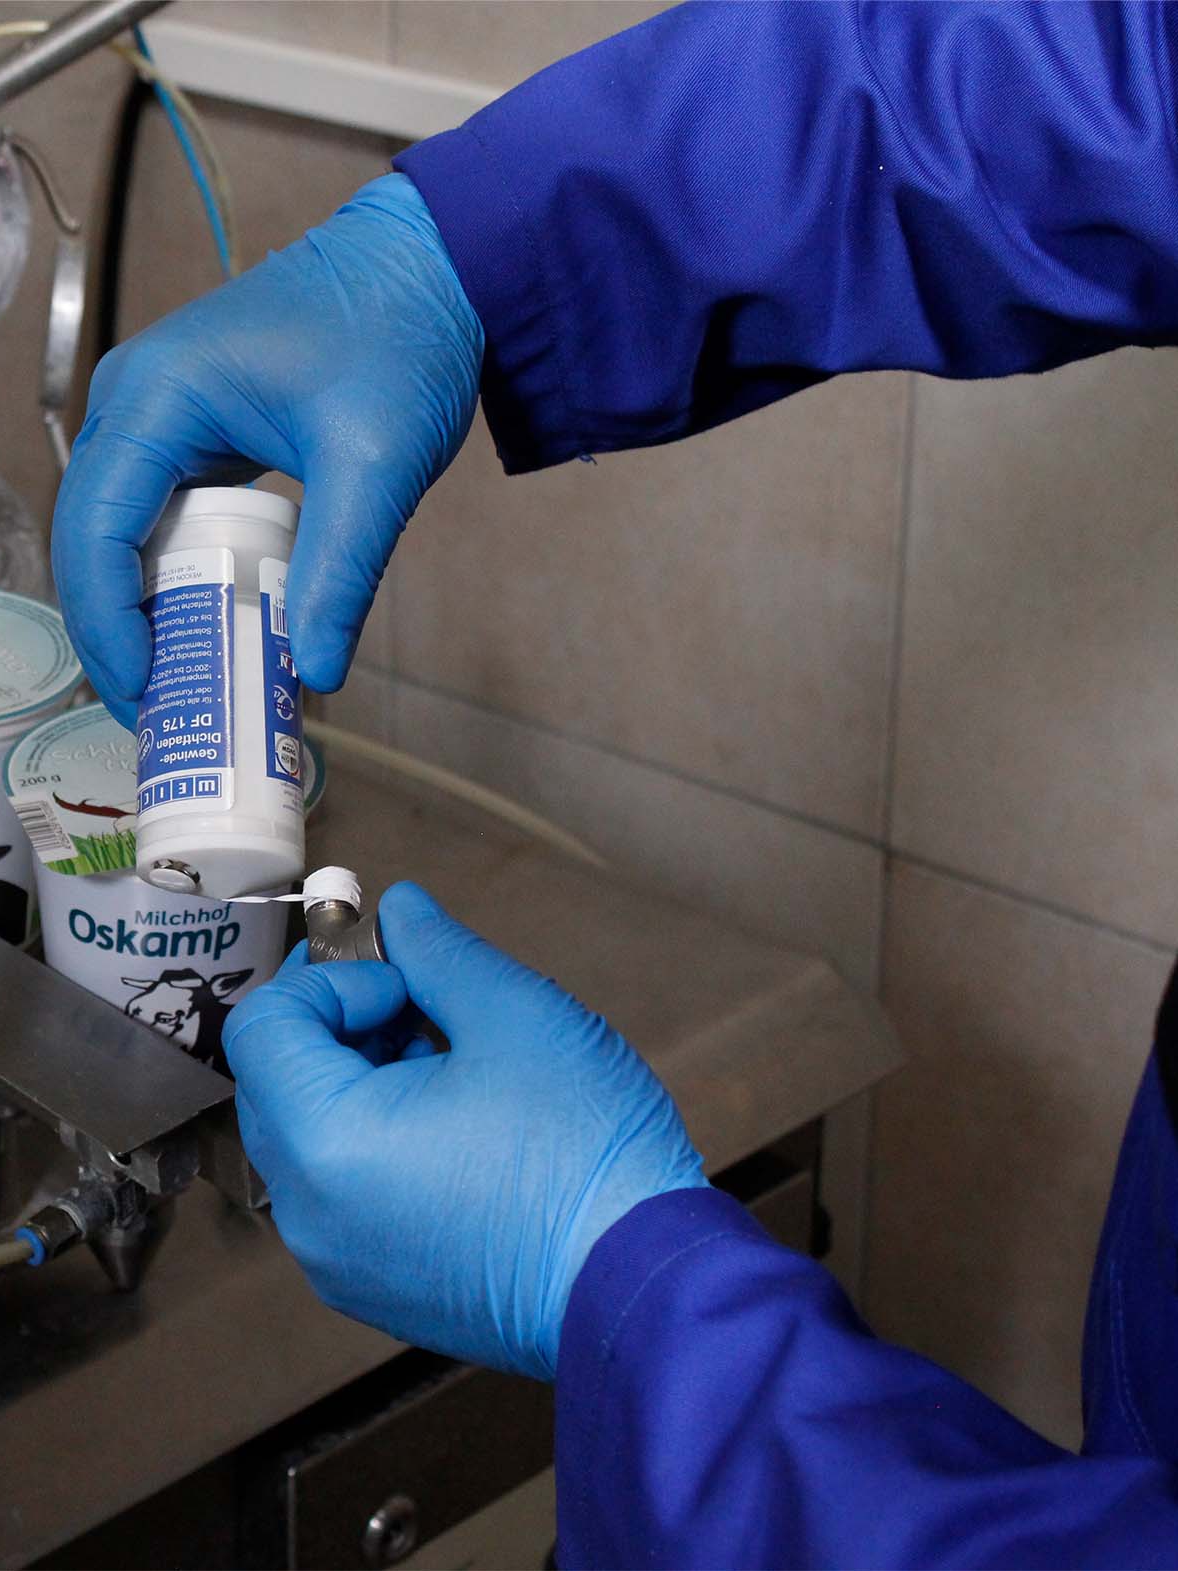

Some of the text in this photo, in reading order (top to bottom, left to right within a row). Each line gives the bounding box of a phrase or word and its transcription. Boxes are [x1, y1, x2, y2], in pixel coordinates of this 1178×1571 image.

[151, 601, 212, 618] einfache Handhab
[154, 618, 184, 630] Rückdreh
[167, 627, 212, 639] Solaranlagen
[174, 667, 184, 675] bis
[195, 687, 212, 695] oder
[162, 716, 186, 732] 175
[190, 713, 212, 727] DF
[157, 733, 221, 749] Dichtfaden
[159, 749, 217, 763] Gewinde-
[18, 775, 47, 788] 200
[137, 779, 216, 814] WEIC
[134, 901, 233, 926] Milchhof
[68, 908, 240, 961] Oskamp
